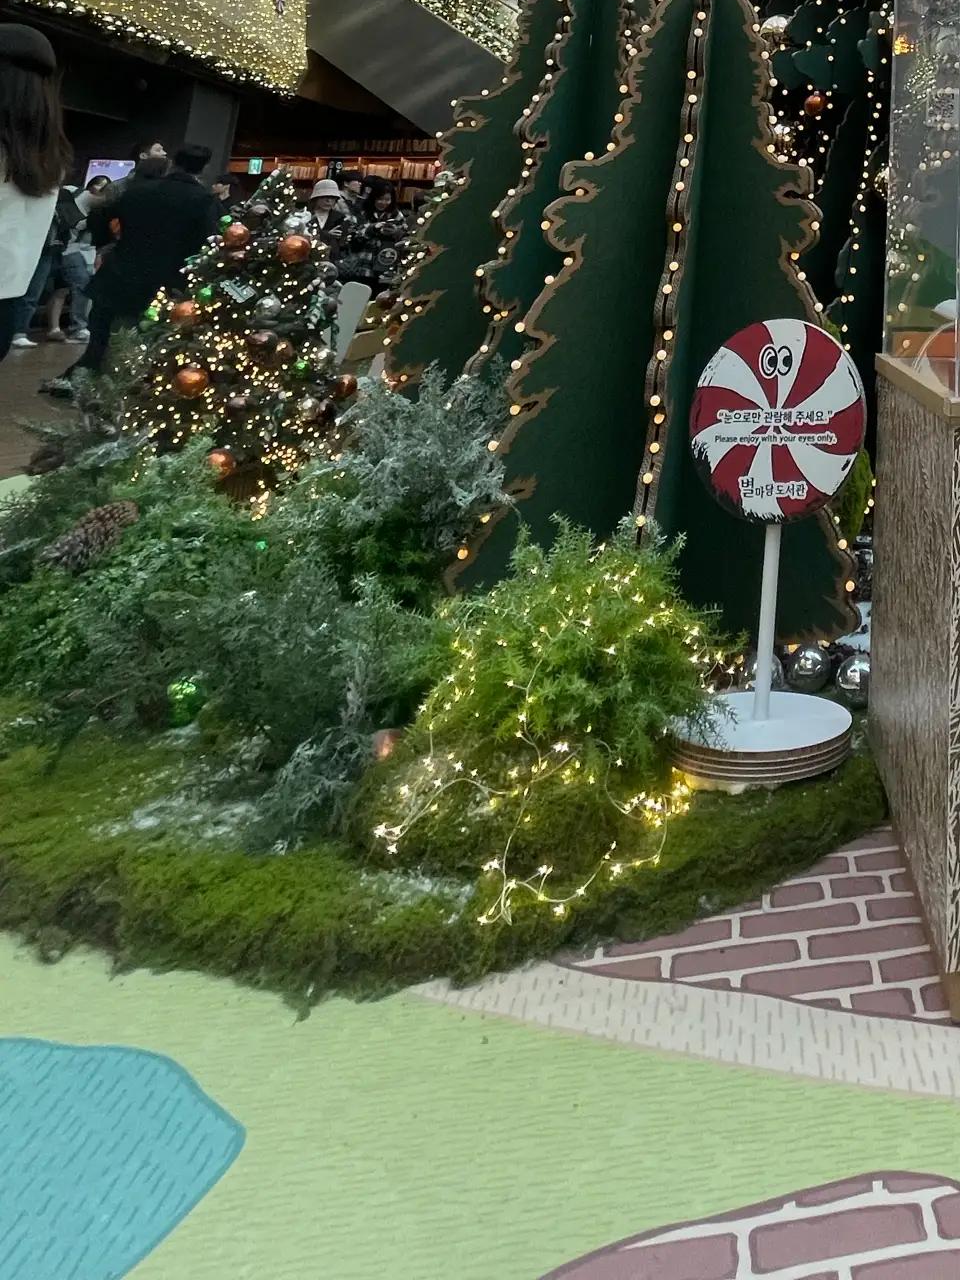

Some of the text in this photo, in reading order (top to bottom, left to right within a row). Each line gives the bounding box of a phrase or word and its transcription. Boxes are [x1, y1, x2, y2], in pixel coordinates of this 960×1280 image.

[764, 411, 793, 424] 관람해
[714, 434, 837, 445] Please enjoy with your eyes only.
